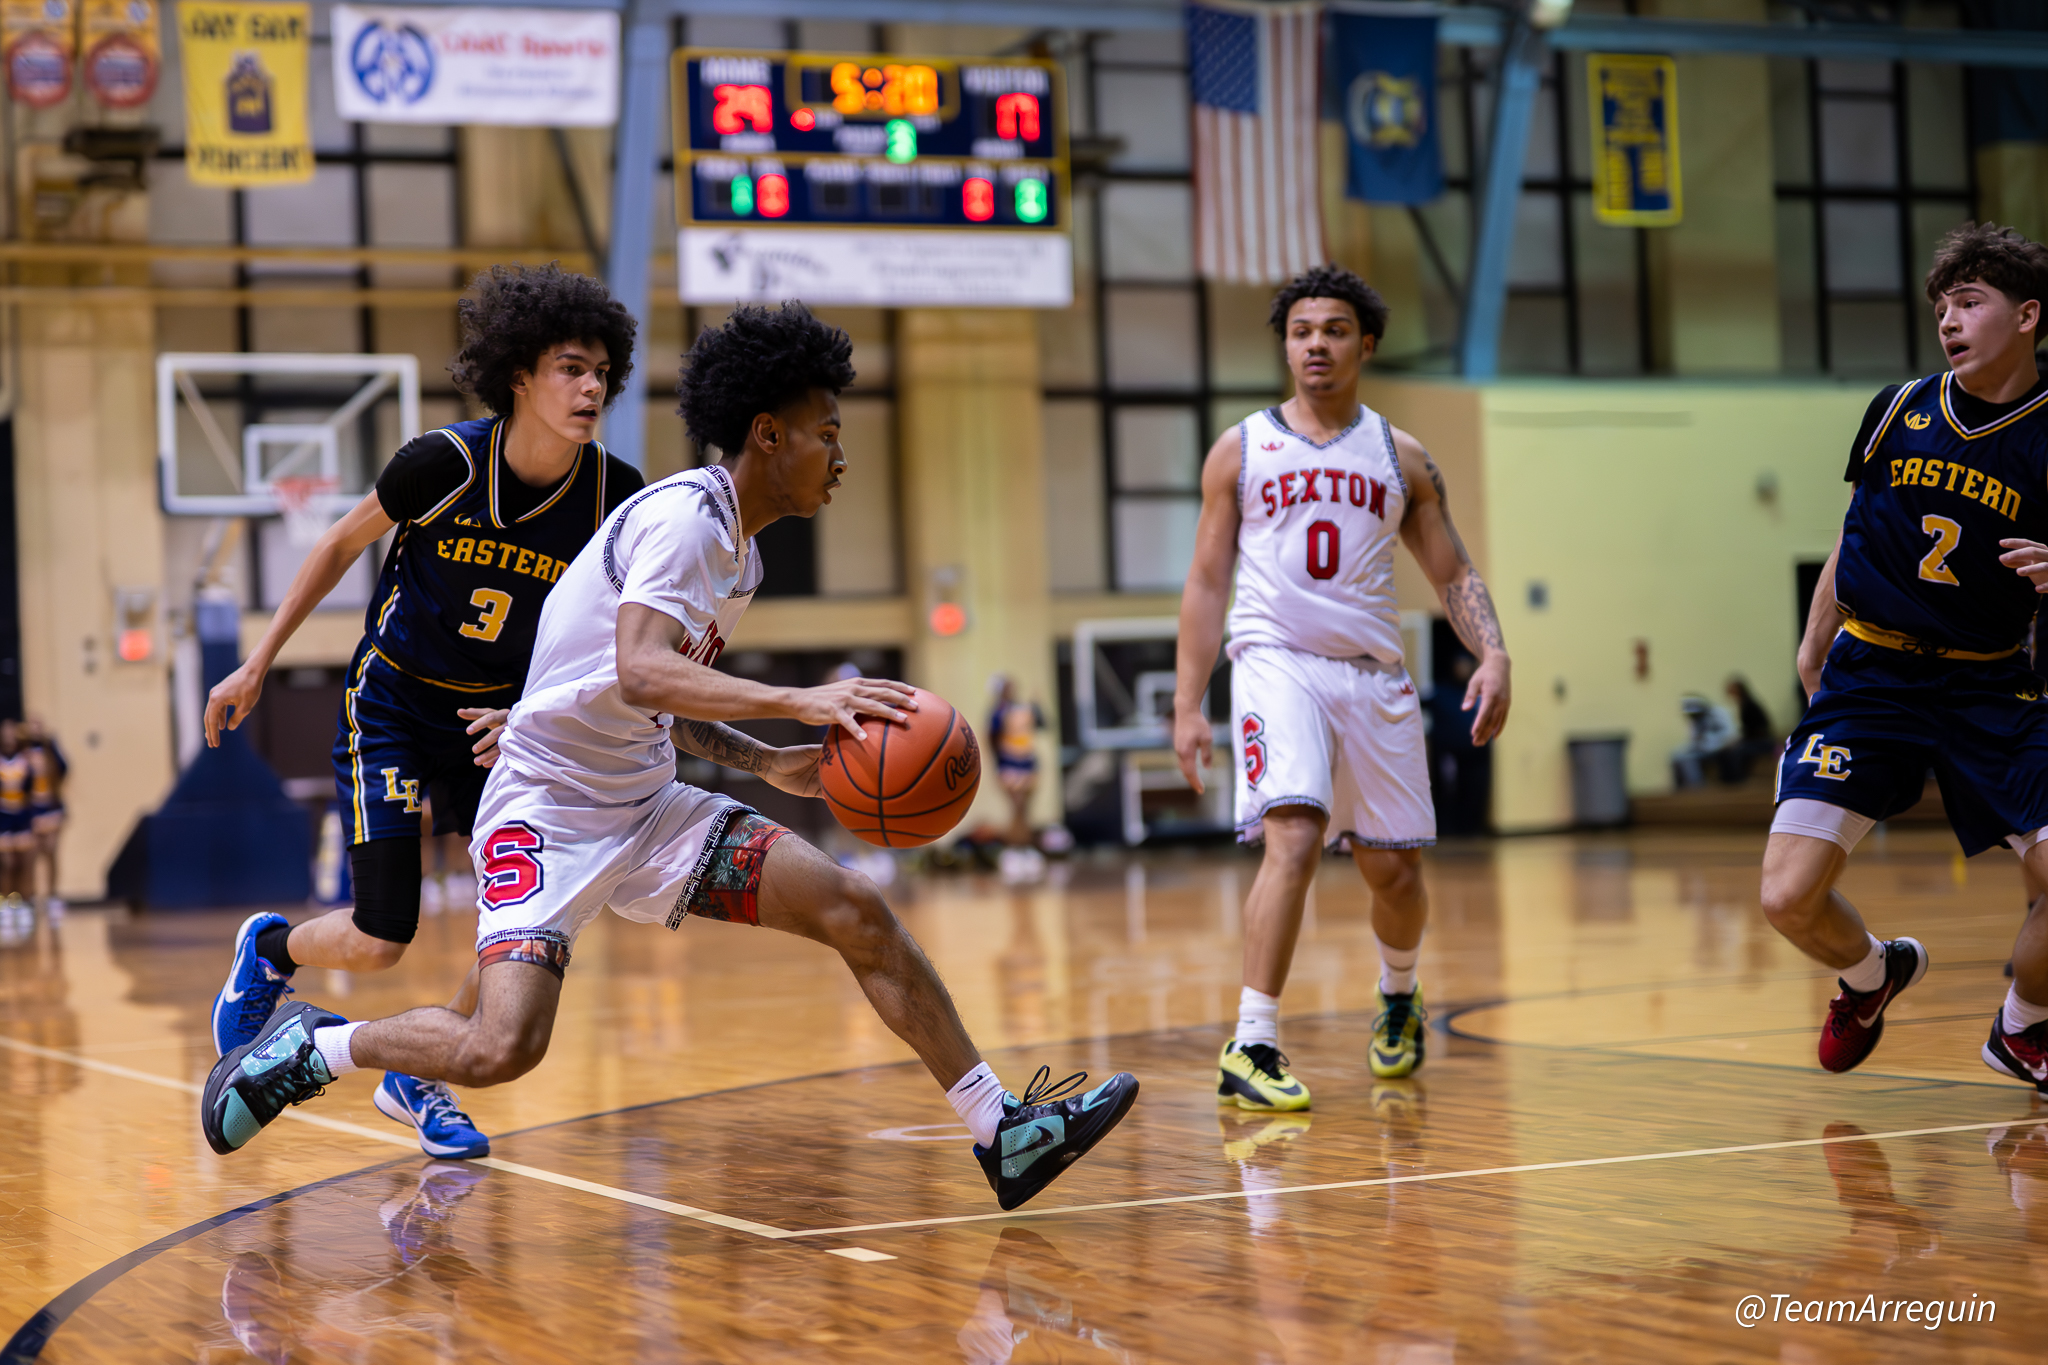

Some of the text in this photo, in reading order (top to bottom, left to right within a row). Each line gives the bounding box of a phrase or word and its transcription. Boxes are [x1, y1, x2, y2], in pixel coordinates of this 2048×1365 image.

[1261, 468, 1387, 521] SEXTON
[1890, 457, 2021, 522] EASTERN
[1307, 519, 1340, 580] 0
[1918, 513, 1962, 586] 2
[458, 587, 513, 642] 3
[1797, 733, 1852, 781] LE
[381, 766, 422, 813] LE
[480, 820, 544, 912] S
